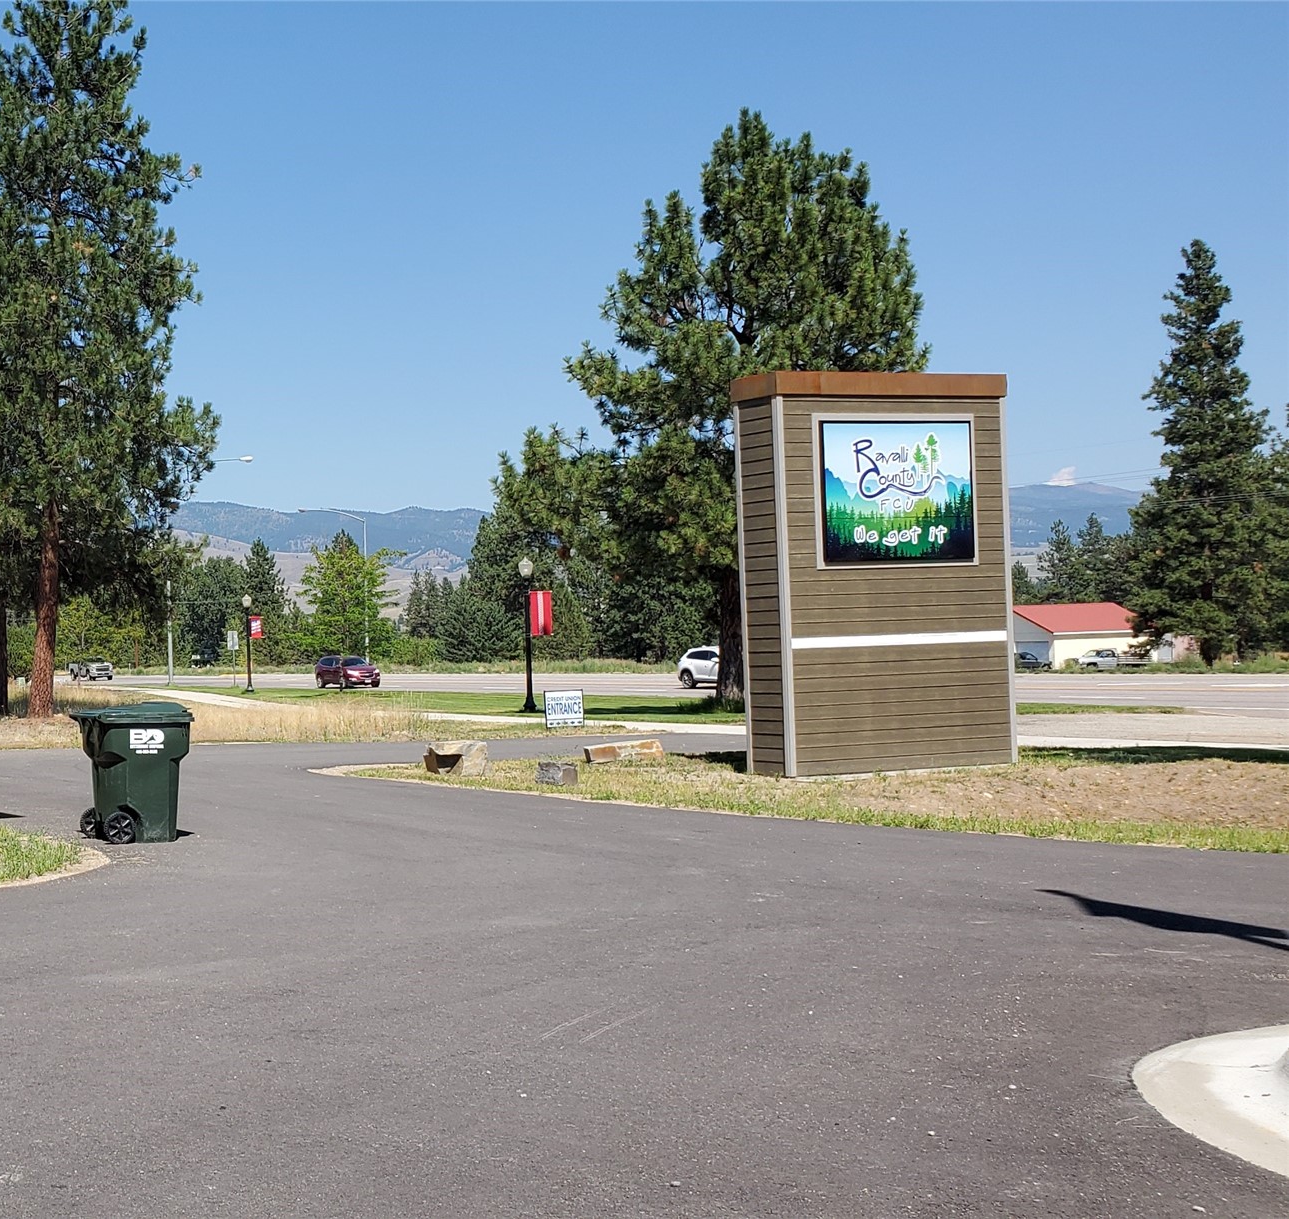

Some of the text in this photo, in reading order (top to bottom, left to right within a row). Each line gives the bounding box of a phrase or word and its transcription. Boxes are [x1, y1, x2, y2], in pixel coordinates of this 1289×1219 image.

[852, 439, 909, 474] Ravalli
[858, 467, 917, 499] County
[854, 525, 947, 545] We get it
[547, 702, 582, 715] ENTRANCE
